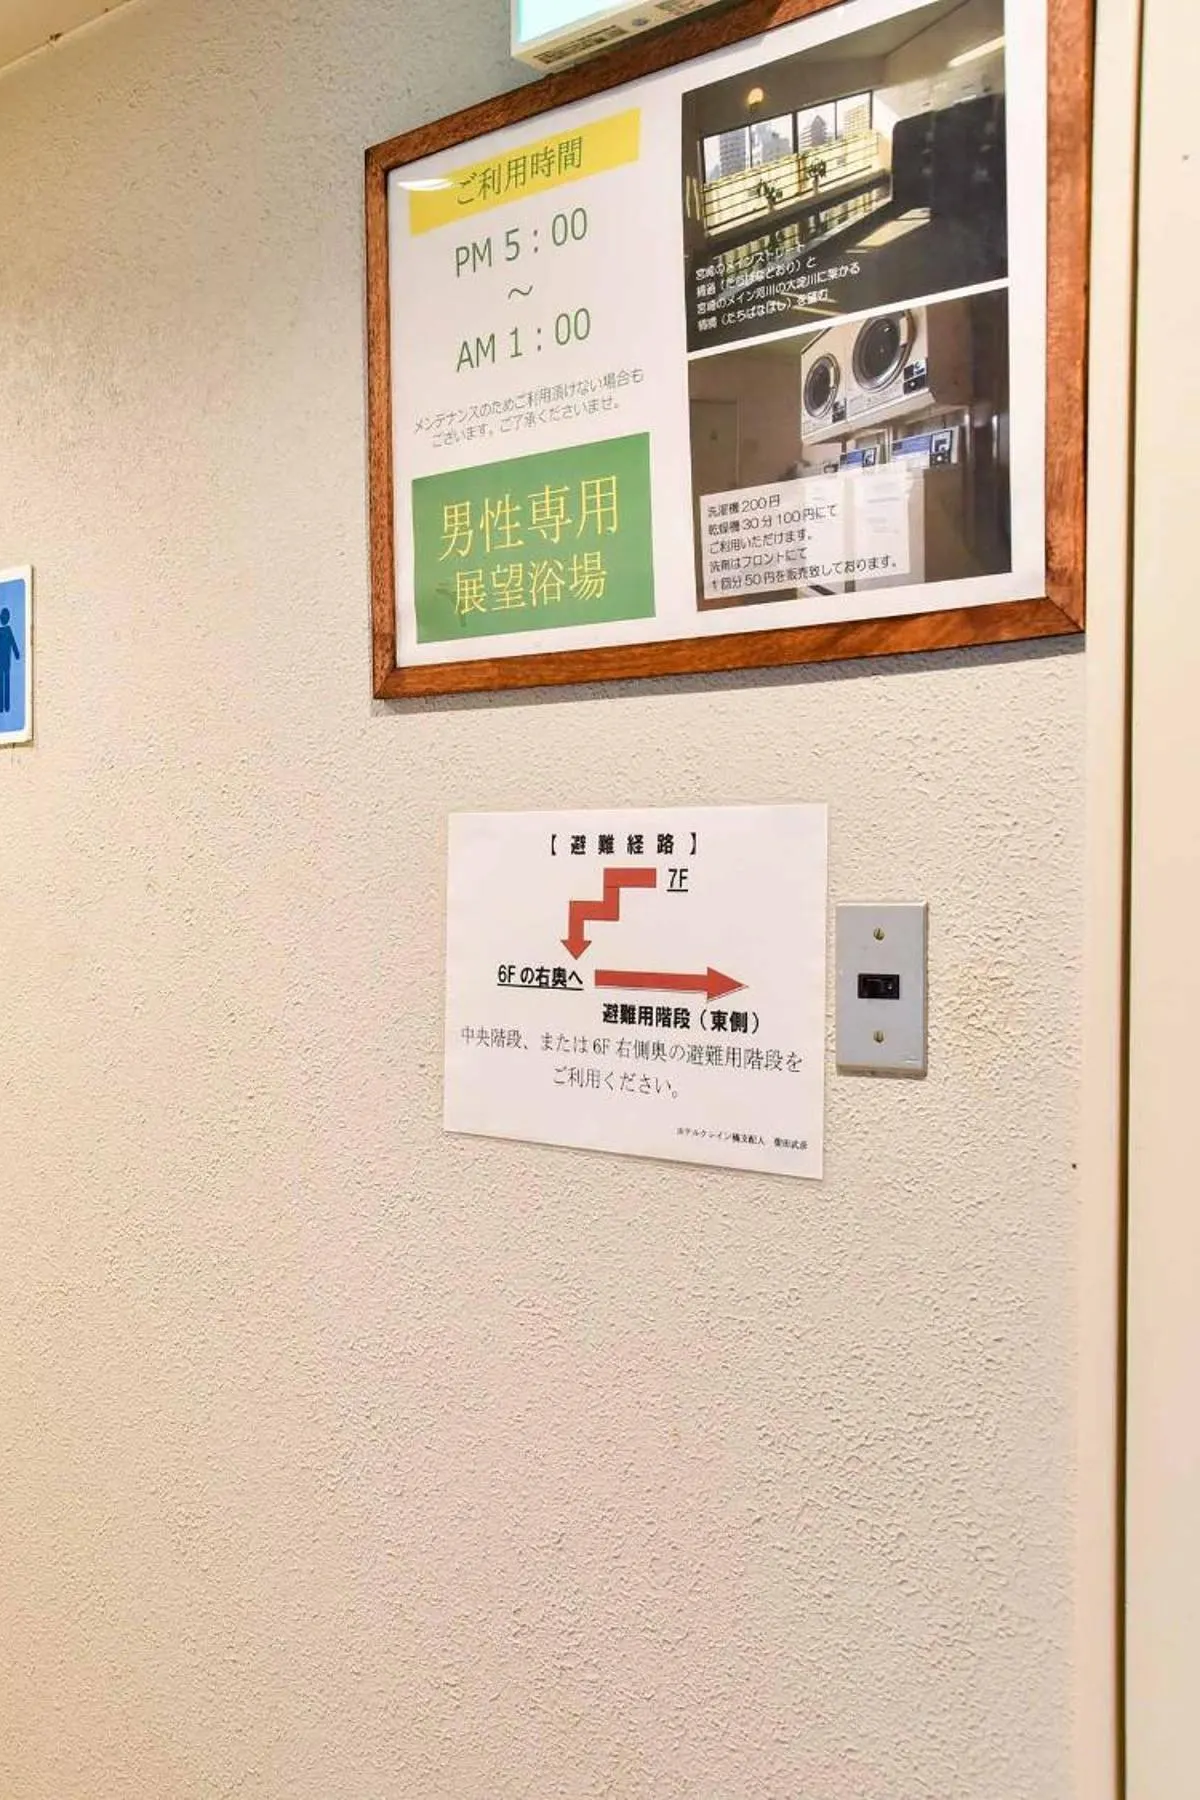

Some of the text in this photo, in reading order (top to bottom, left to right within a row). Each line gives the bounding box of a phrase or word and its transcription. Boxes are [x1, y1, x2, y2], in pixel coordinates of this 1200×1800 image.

[457, 136, 583, 206] ご利用時間
[455, 237, 492, 278] PM
[456, 333, 495, 373] AM
[439, 475, 618, 562] 男性専用
[454, 551, 608, 615] 展望浴場
[666, 867, 690, 892] 7F
[601, 1002, 760, 1036] 避難用階段（東側）
[552, 1067, 679, 1100] ご利用ください。
